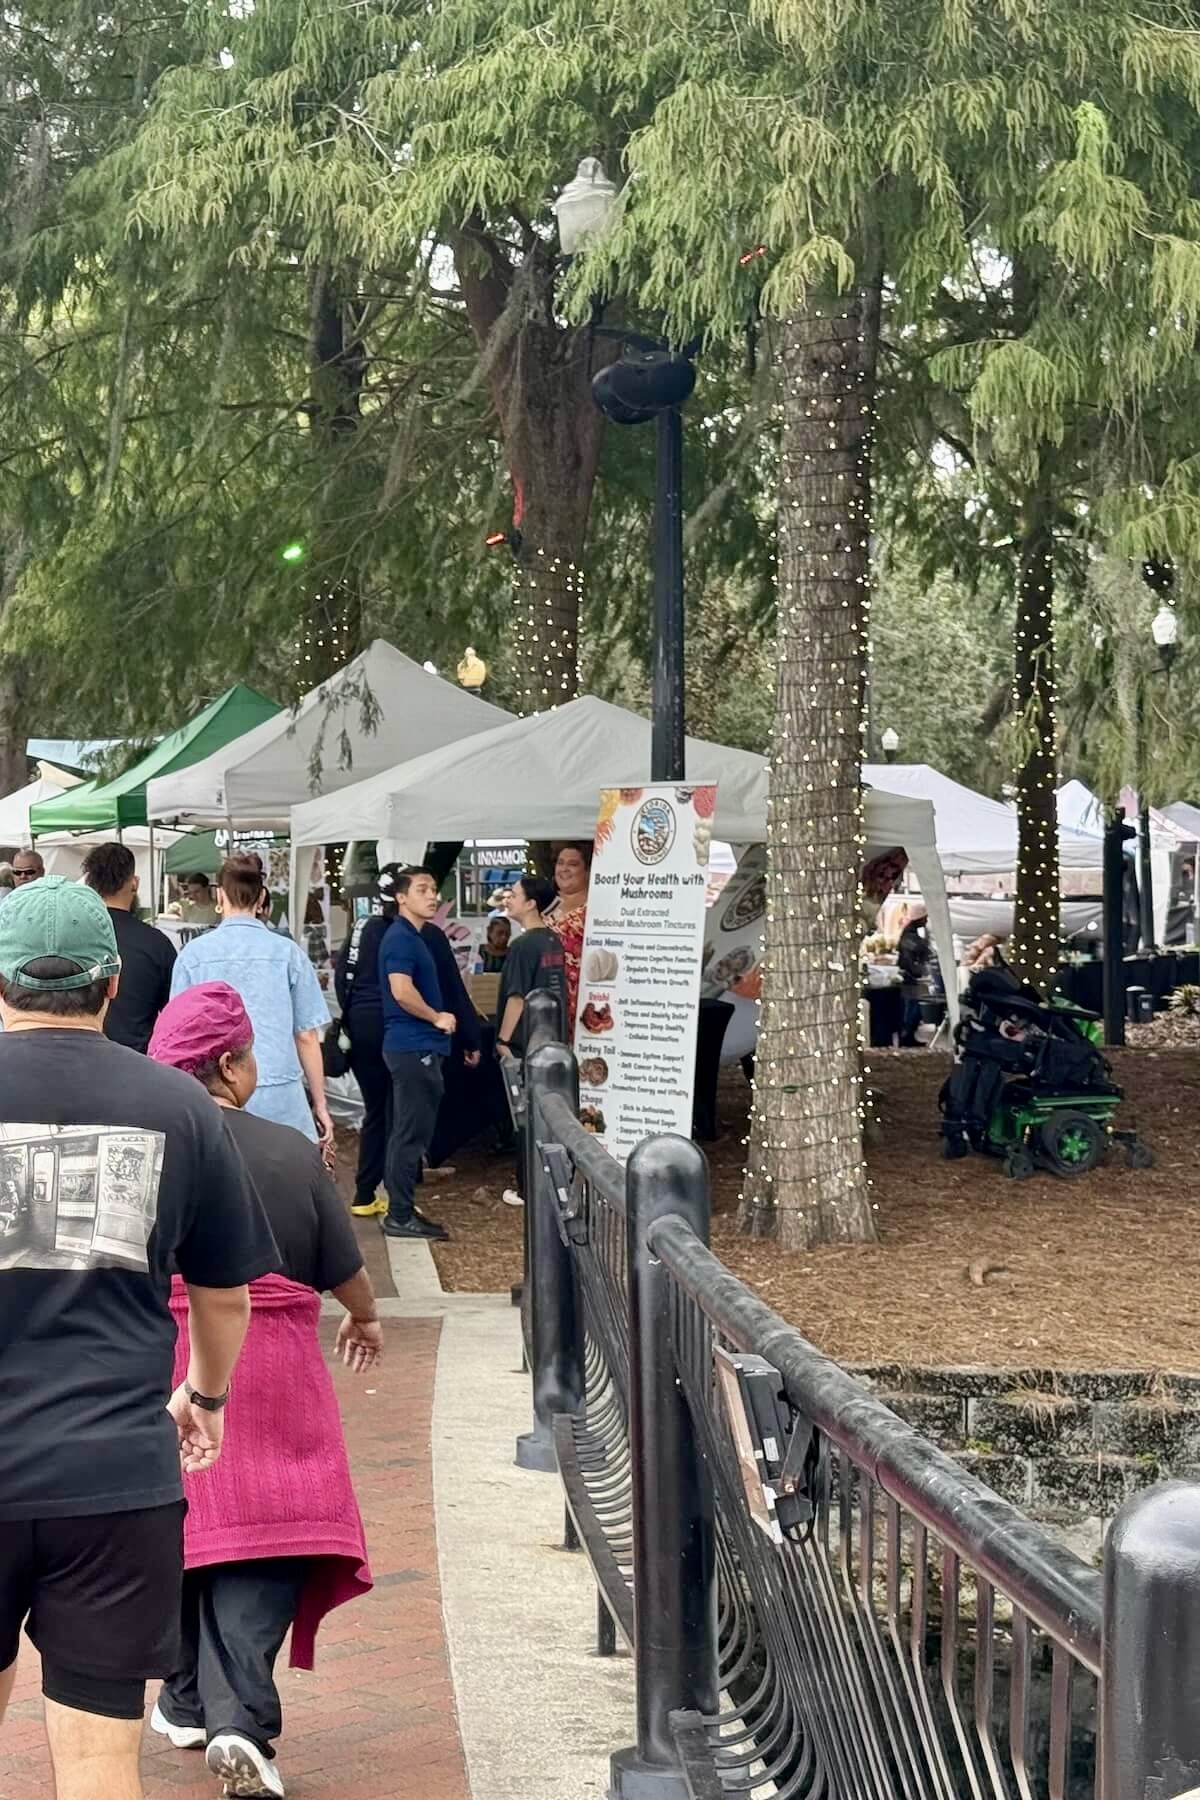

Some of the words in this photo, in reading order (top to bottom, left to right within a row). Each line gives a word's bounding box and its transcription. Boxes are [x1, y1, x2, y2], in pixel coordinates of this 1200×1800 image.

[594, 873, 620, 885] Boost
[623, 873, 645, 886] Your
[648, 874, 680, 885] Health
[682, 874, 704, 886] with
[620, 888, 673, 900] Mushrooms
[620, 908, 636, 916] Dual
[637, 908, 670, 917] Extracted
[593, 918, 625, 928] Medicinal
[626, 919, 662, 928] Mushroom
[664, 920, 696, 930] Tinctures
[578, 1043, 600, 1056] Turkey
[603, 1046, 616, 1055] Tail
[662, 1054, 684, 1062] Support
[637, 1086, 656, 1096] Energy
